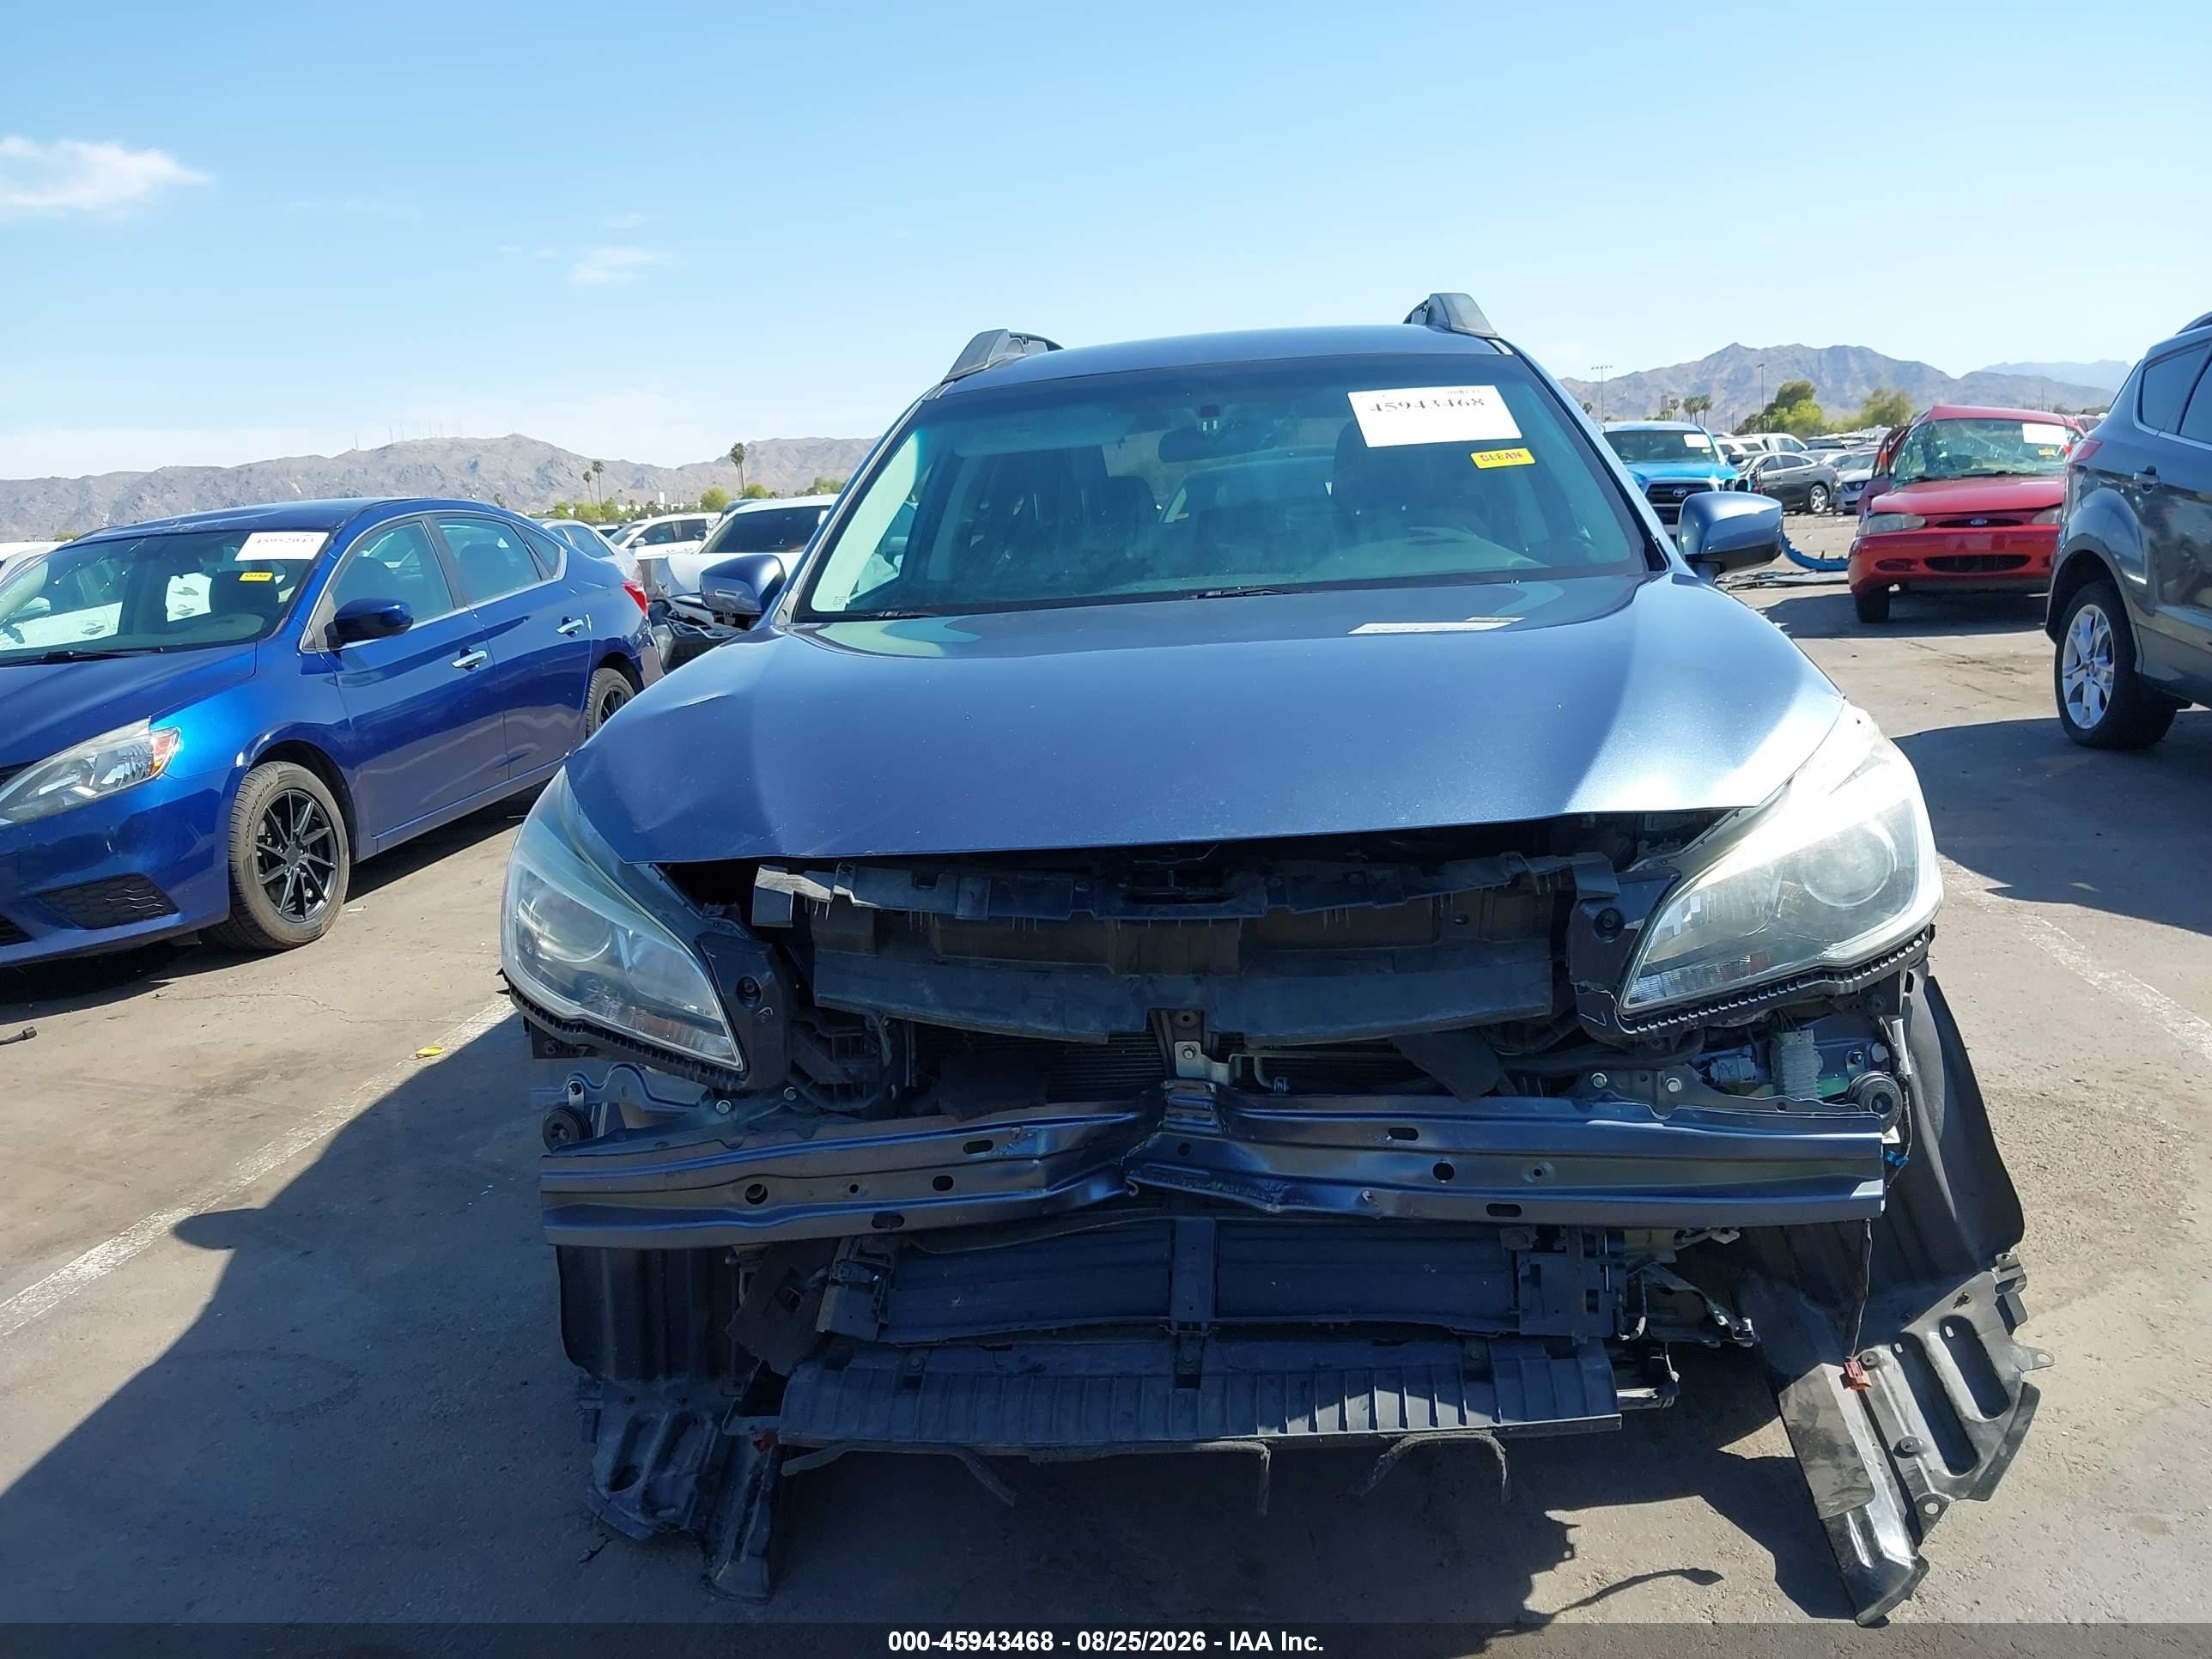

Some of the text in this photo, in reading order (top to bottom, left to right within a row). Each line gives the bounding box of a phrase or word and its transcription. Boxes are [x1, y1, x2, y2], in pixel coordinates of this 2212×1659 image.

[1368, 397, 1485, 413] 45943468
[1479, 452, 1523, 462] CLEAN
[244, 780, 275, 848] CONTINENTAL
